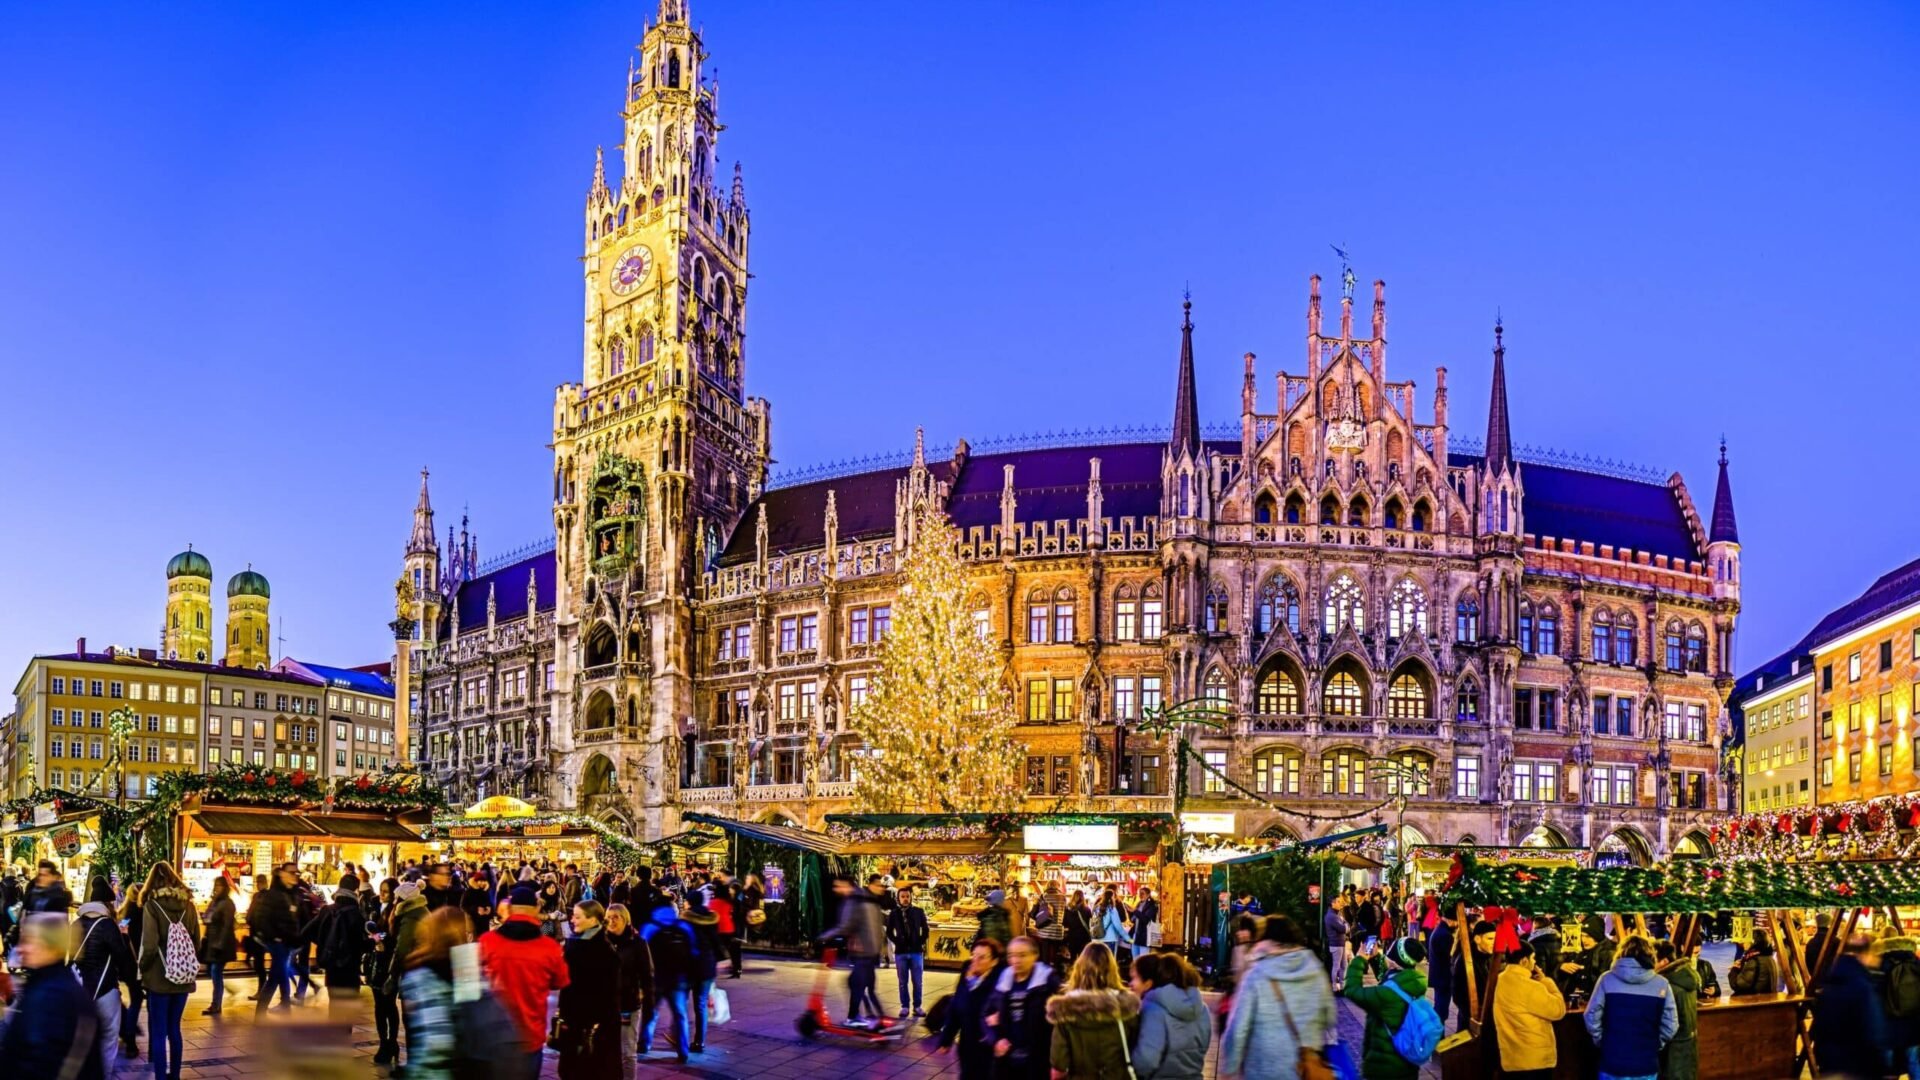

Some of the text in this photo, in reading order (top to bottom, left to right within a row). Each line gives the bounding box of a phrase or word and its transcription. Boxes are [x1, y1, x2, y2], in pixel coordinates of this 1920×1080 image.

[480, 801, 521, 813] Glühwein
[451, 826, 481, 837] Glühwein
[525, 824, 560, 835] Glühwein
